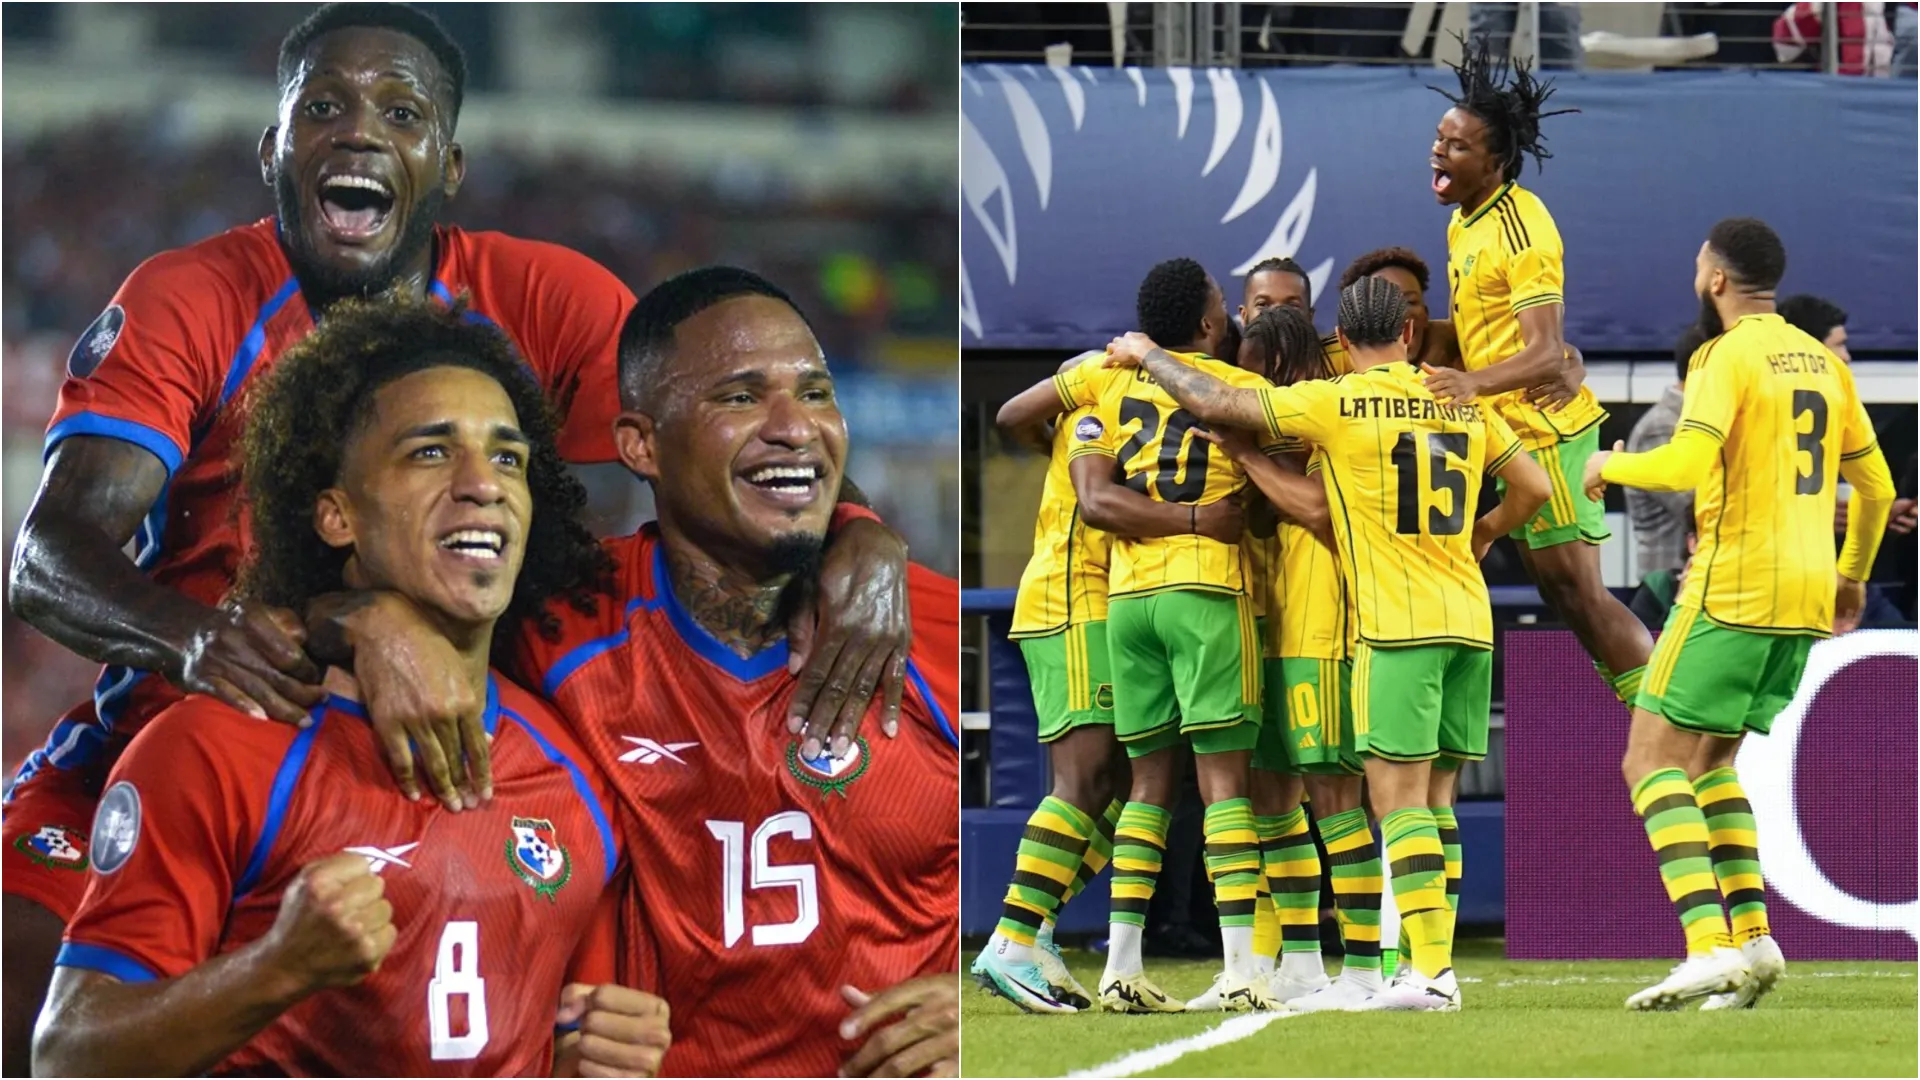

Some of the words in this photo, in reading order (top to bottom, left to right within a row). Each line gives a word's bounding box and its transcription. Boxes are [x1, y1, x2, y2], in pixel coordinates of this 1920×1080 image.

[1766, 352, 1829, 374] HECTOR
[1114, 396, 1211, 504] 20
[1391, 432, 1469, 535] 15
[1792, 389, 1829, 495] 3
[1287, 682, 1320, 731] 10
[705, 811, 820, 949] 15
[427, 921, 490, 1061] 8
